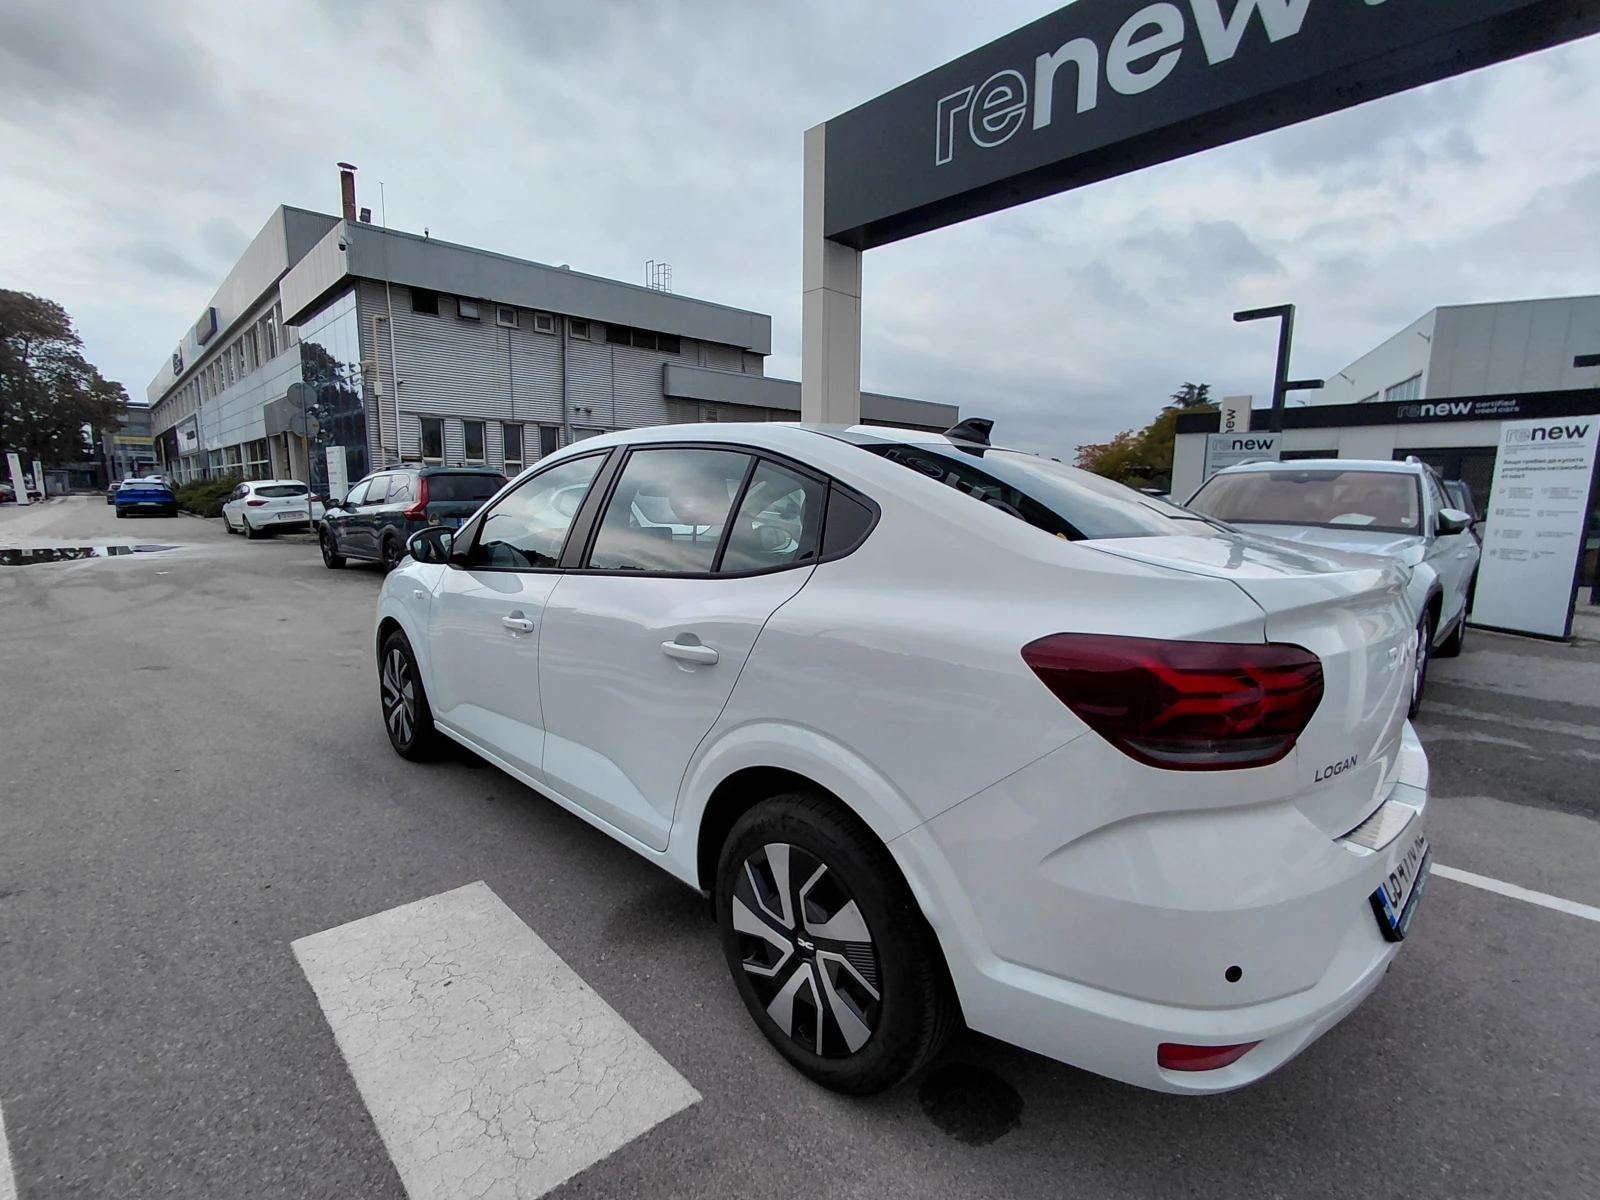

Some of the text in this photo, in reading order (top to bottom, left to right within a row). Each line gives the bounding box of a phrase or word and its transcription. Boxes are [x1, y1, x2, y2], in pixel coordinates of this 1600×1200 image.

[935, 0, 1313, 166] renew
[1397, 402, 1473, 418] renew
[1475, 399, 1516, 408] certified
[1506, 424, 1589, 442] renew
[1212, 439, 1274, 451] renew
[1314, 754, 1358, 783] LOGAN
